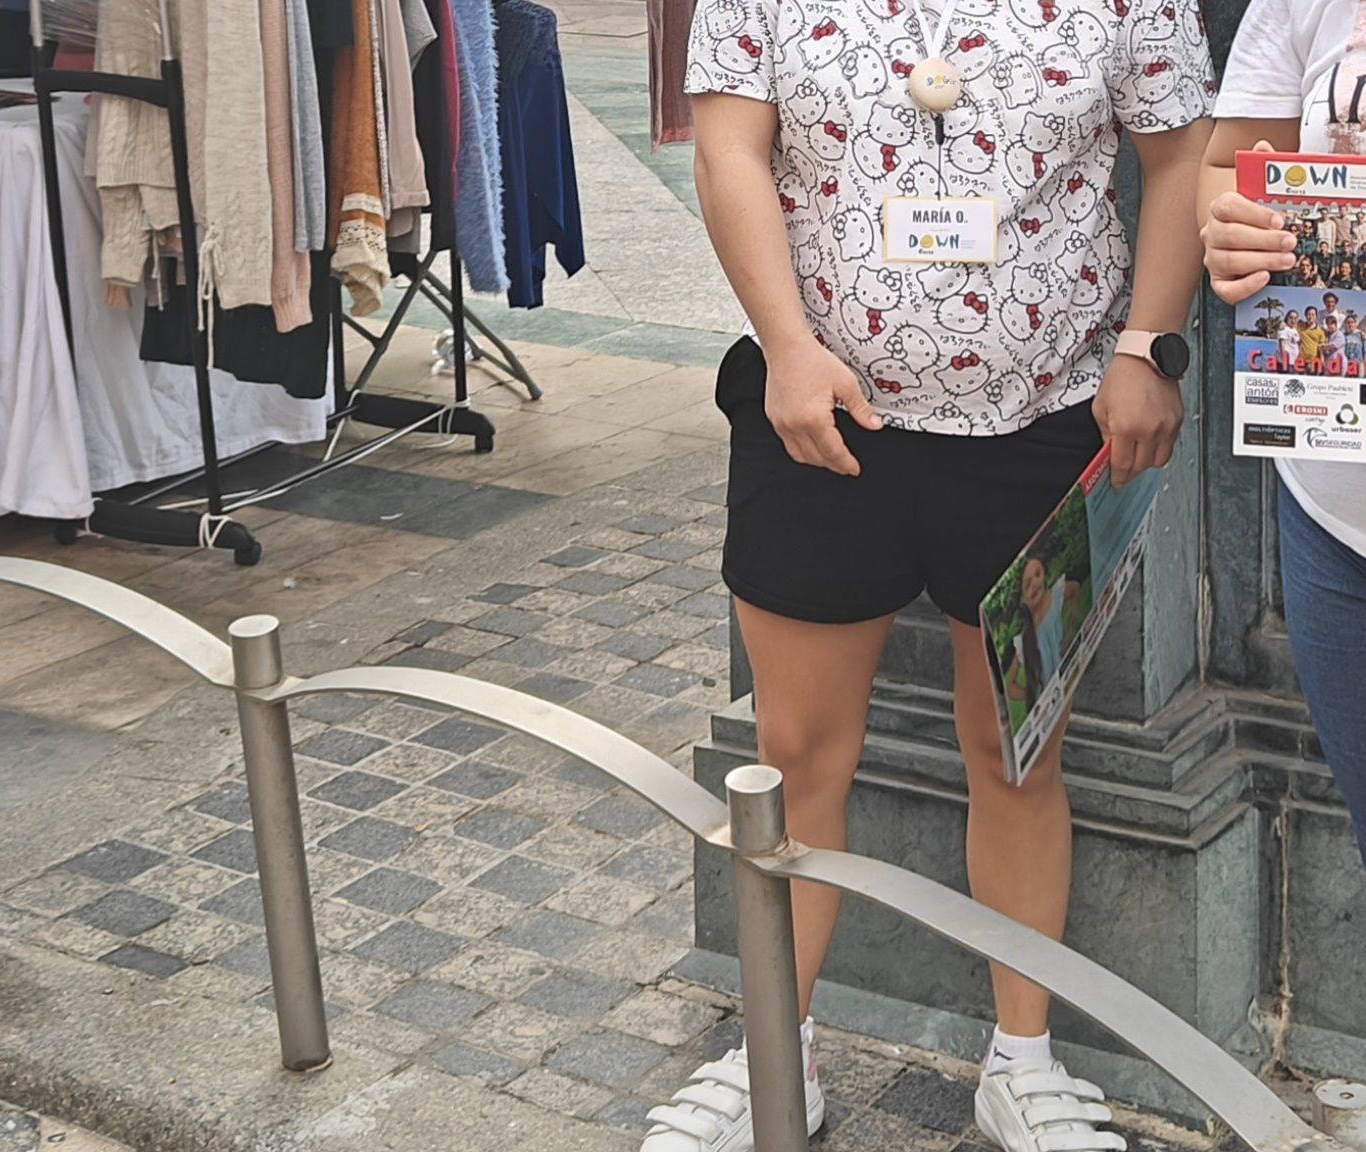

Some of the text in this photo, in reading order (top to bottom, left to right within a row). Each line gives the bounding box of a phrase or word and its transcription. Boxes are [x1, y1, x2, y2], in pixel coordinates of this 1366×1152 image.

[1266, 163, 1347, 189] DOWN
[912, 206, 951, 223] MARÍA
[908, 233, 959, 249] DOWN
[1296, 406, 1327, 415] EROSKI
